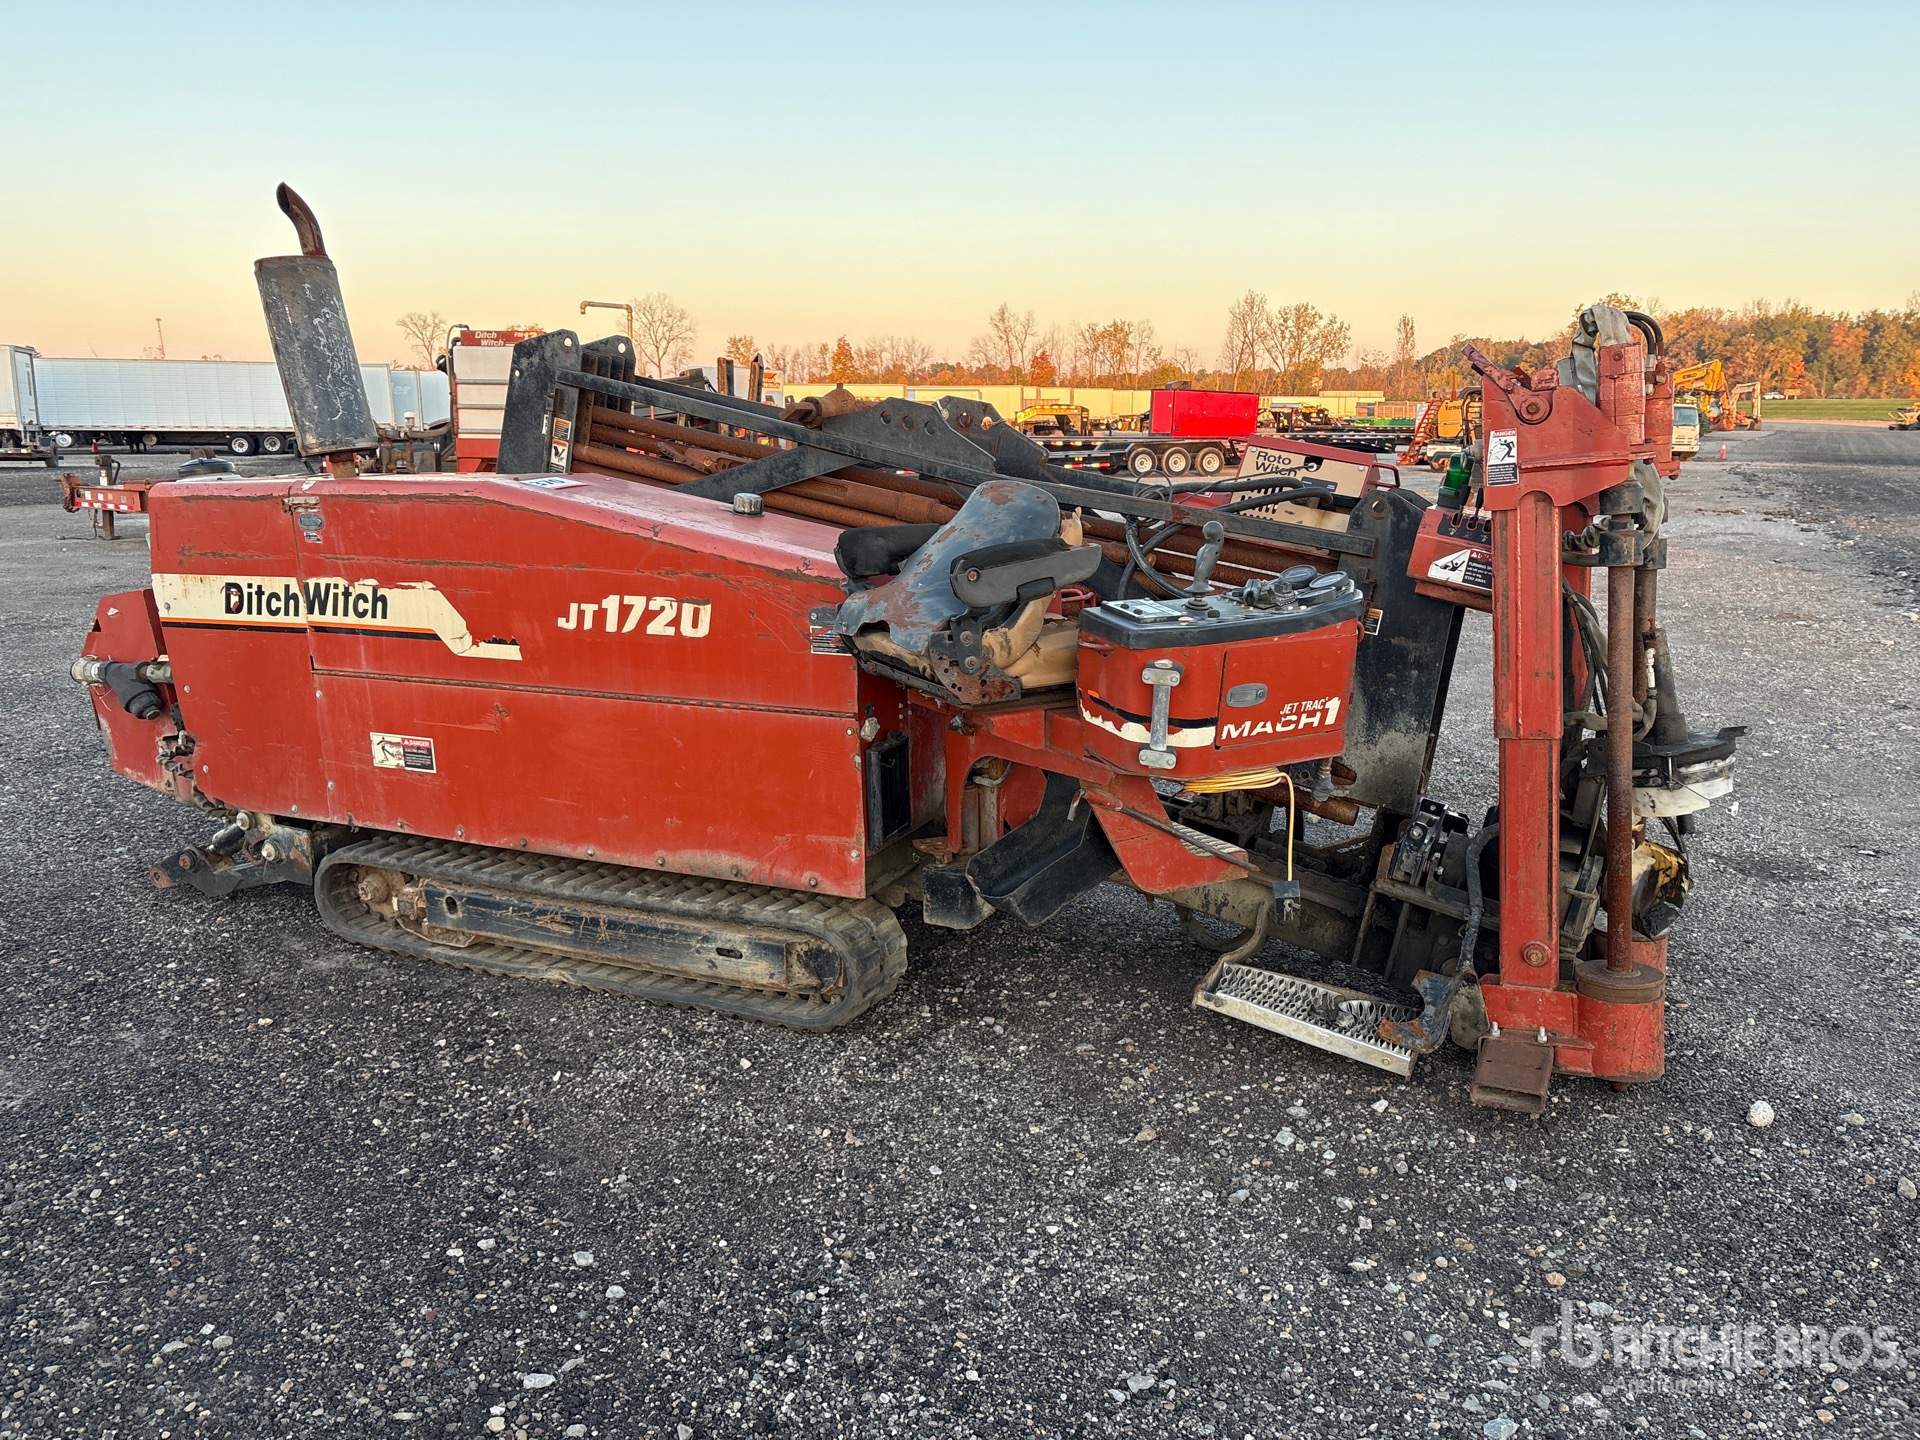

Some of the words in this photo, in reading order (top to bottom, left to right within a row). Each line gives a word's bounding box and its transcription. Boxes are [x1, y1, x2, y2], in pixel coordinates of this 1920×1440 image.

[480, 338, 504, 346] Witch
[1256, 451, 1292, 466] Roto
[1255, 461, 1298, 477] Witch
[225, 581, 300, 617] Ditch
[303, 582, 387, 620] Witch
[1280, 702, 1300, 715] JET
